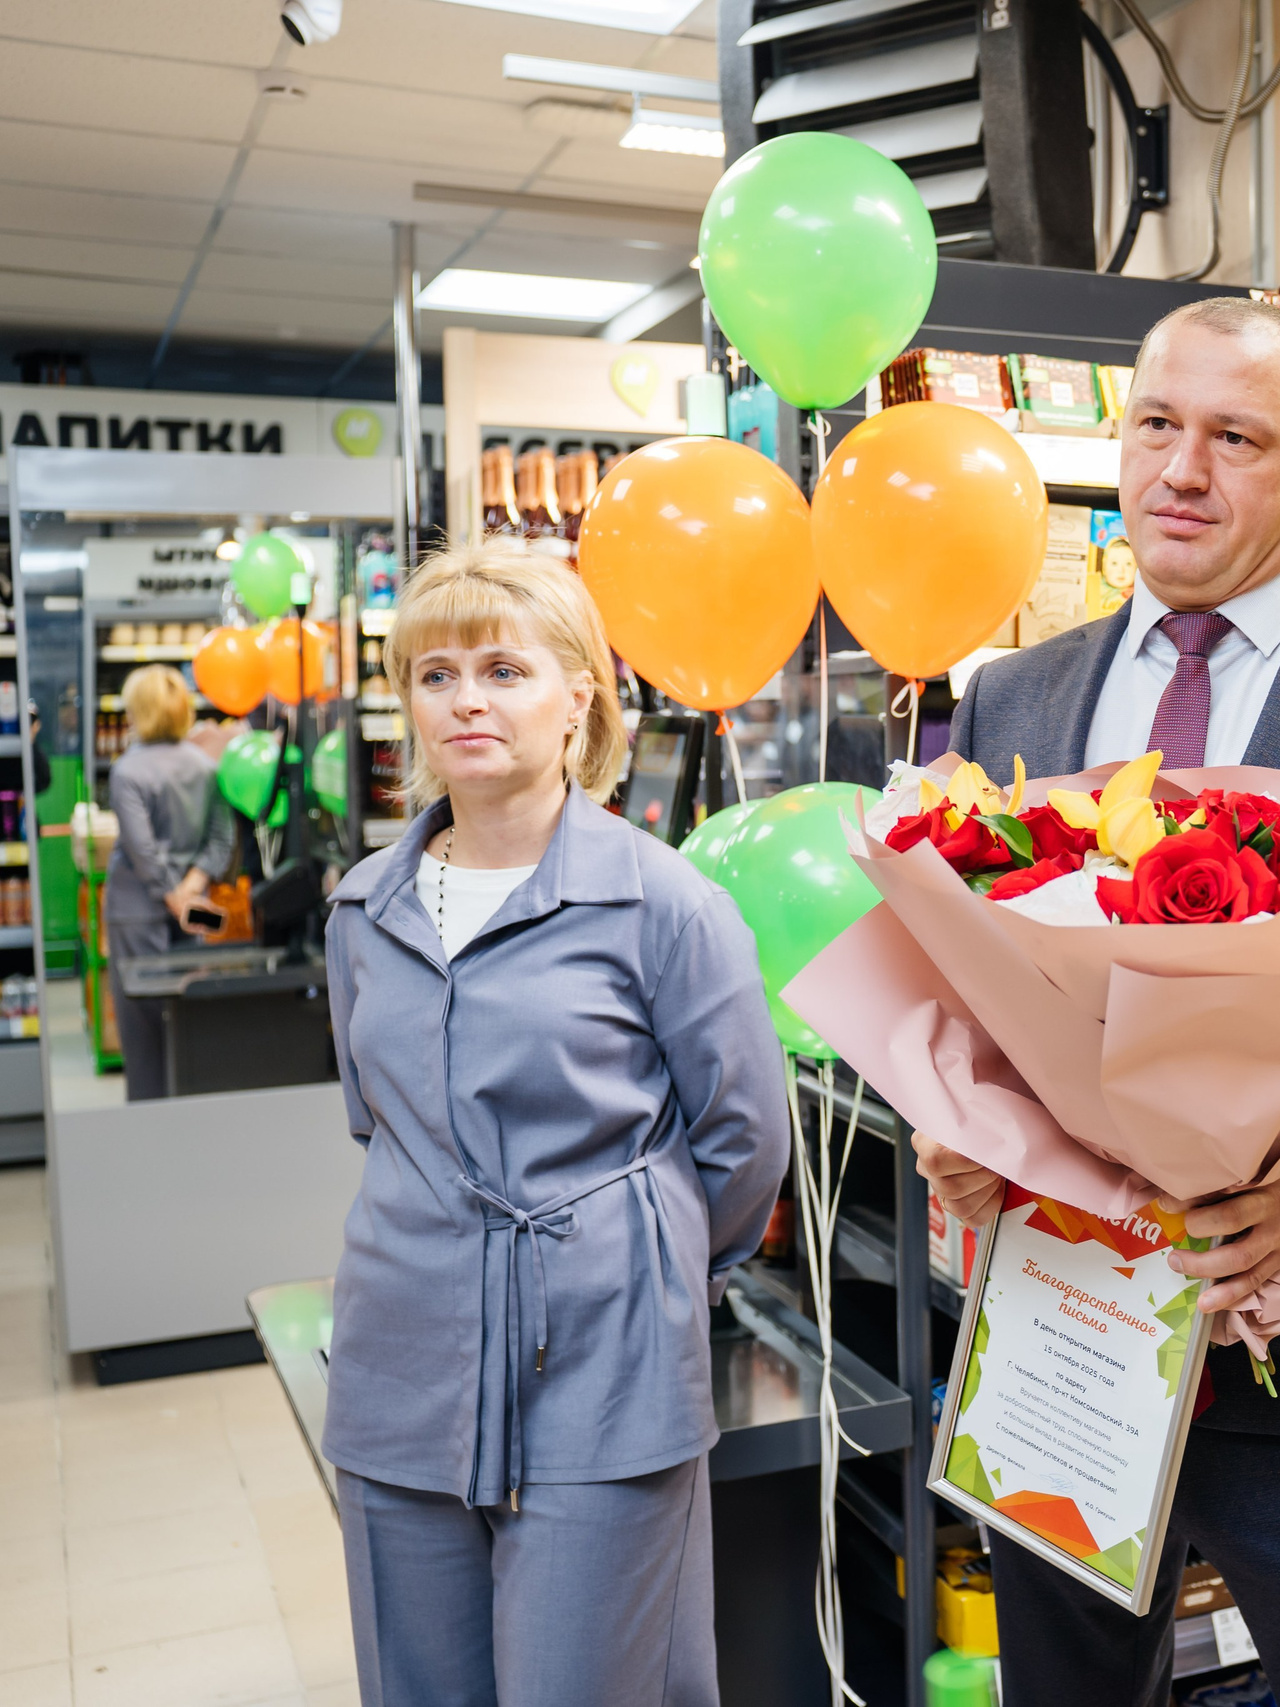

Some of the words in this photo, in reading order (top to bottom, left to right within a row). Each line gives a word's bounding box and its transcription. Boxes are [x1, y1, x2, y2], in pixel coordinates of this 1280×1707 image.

[0, 411, 284, 454] АПИТКИ
[1022, 1258, 1158, 1337] Благодарственное
[1058, 1301, 1109, 1334] письмо
[1033, 1318, 1039, 1327] В
[1040, 1322, 1058, 1336] день
[1058, 1332, 1092, 1354] открытия
[1092, 1349, 1127, 1372] магазина
[1044, 1344, 1053, 1354] 15
[1053, 1349, 1080, 1369] октября
[1080, 1363, 1098, 1378] 2025
[1098, 1373, 1115, 1388] года
[1014, 1365, 1050, 1390] Челябинск,
[1051, 1385, 1069, 1399] пр-кт
[1070, 1393, 1125, 1430] Комсомольский,
[1055, 1372, 1064, 1381] по
[1064, 1376, 1088, 1394] адресу
[1004, 1395, 1051, 1425] добросовестный
[1103, 1449, 1129, 1468] команду
[1008, 1411, 1035, 1430] большой
[1034, 1426, 1053, 1441] вклад
[1057, 1439, 1085, 1459] развитие
[1019, 1386, 1050, 1408] Вручается
[1050, 1404, 1084, 1427] коллективу
[1083, 1423, 1112, 1442] магазина
[995, 1421, 1001, 1430] С
[1000, 1426, 1043, 1454] пожеланиями
[1043, 1449, 1068, 1468] успехов
[1074, 1466, 1118, 1495] процветания!
